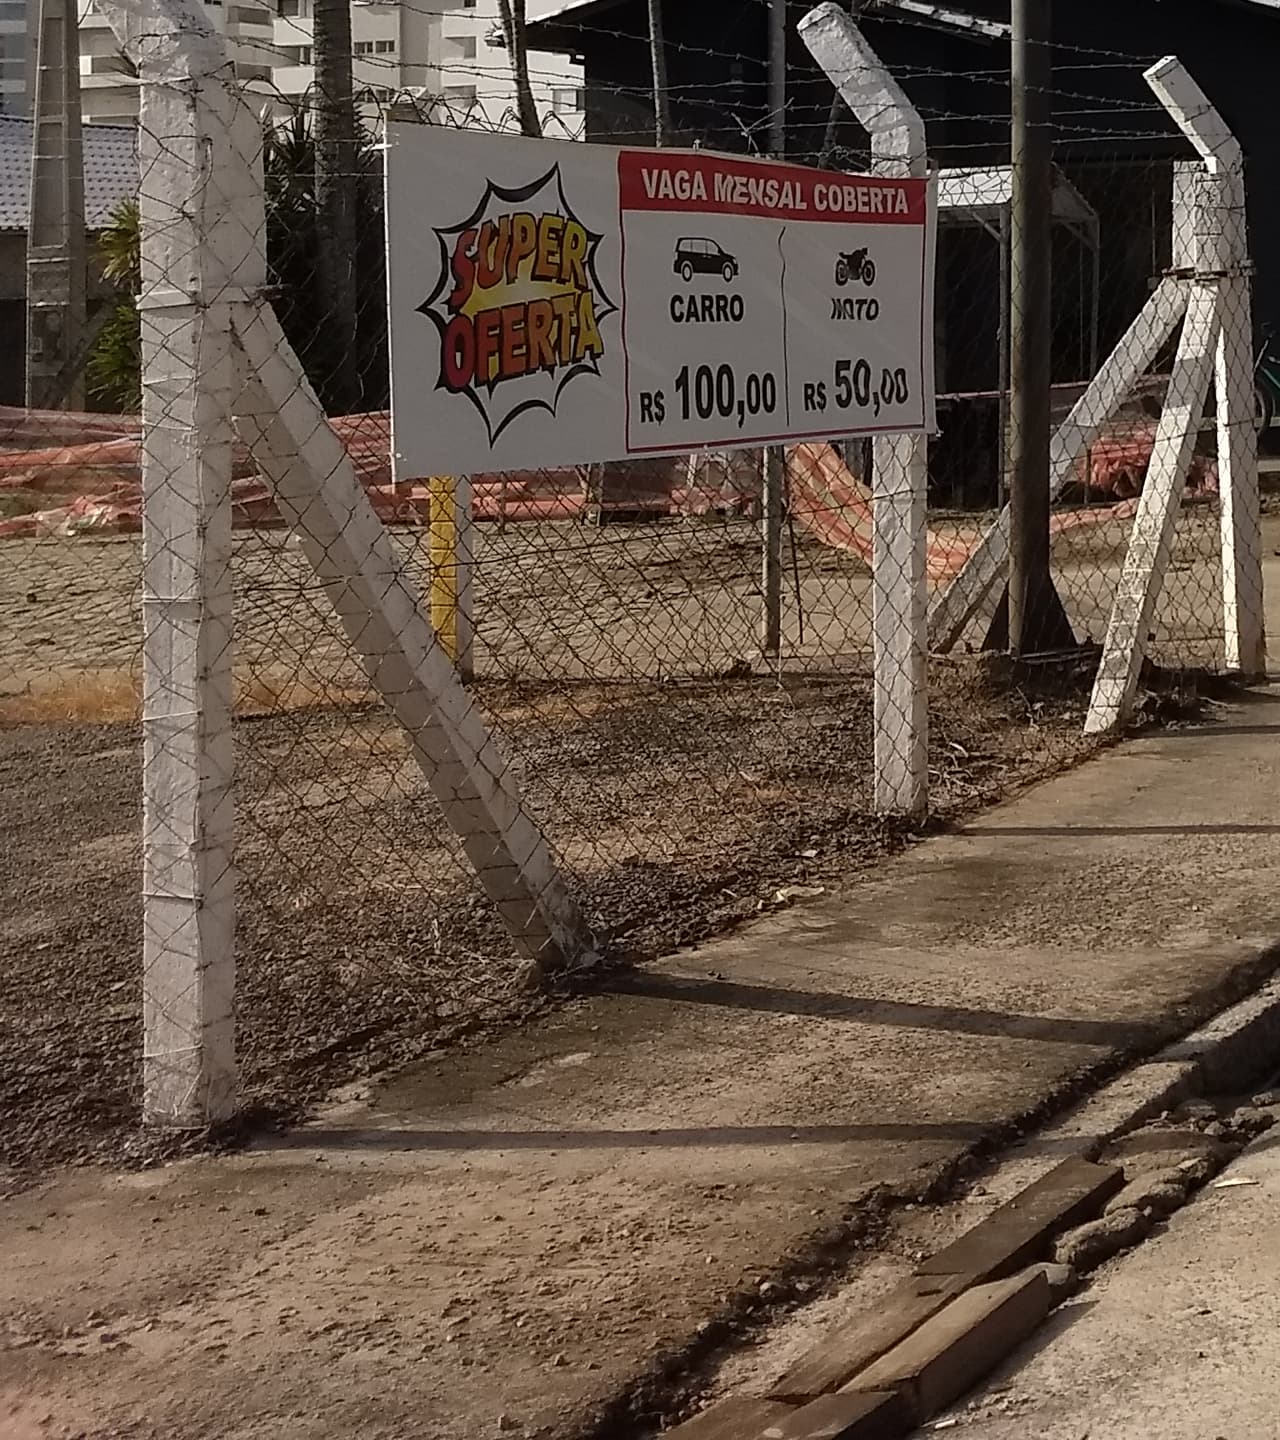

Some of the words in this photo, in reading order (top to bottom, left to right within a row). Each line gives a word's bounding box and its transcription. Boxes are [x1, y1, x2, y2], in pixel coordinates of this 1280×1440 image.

[640, 167, 708, 202] VAGA
[713, 171, 808, 212] MENSAL
[813, 183, 910, 214] COBERTA
[448, 211, 588, 315] SUPER
[442, 289, 604, 392] OFERTA
[669, 294, 745, 324] CARRO
[639, 389, 666, 427] R$
[674, 363, 777, 429] 100,00
[803, 381, 828, 413] R$
[834, 358, 909, 418] 50,00
